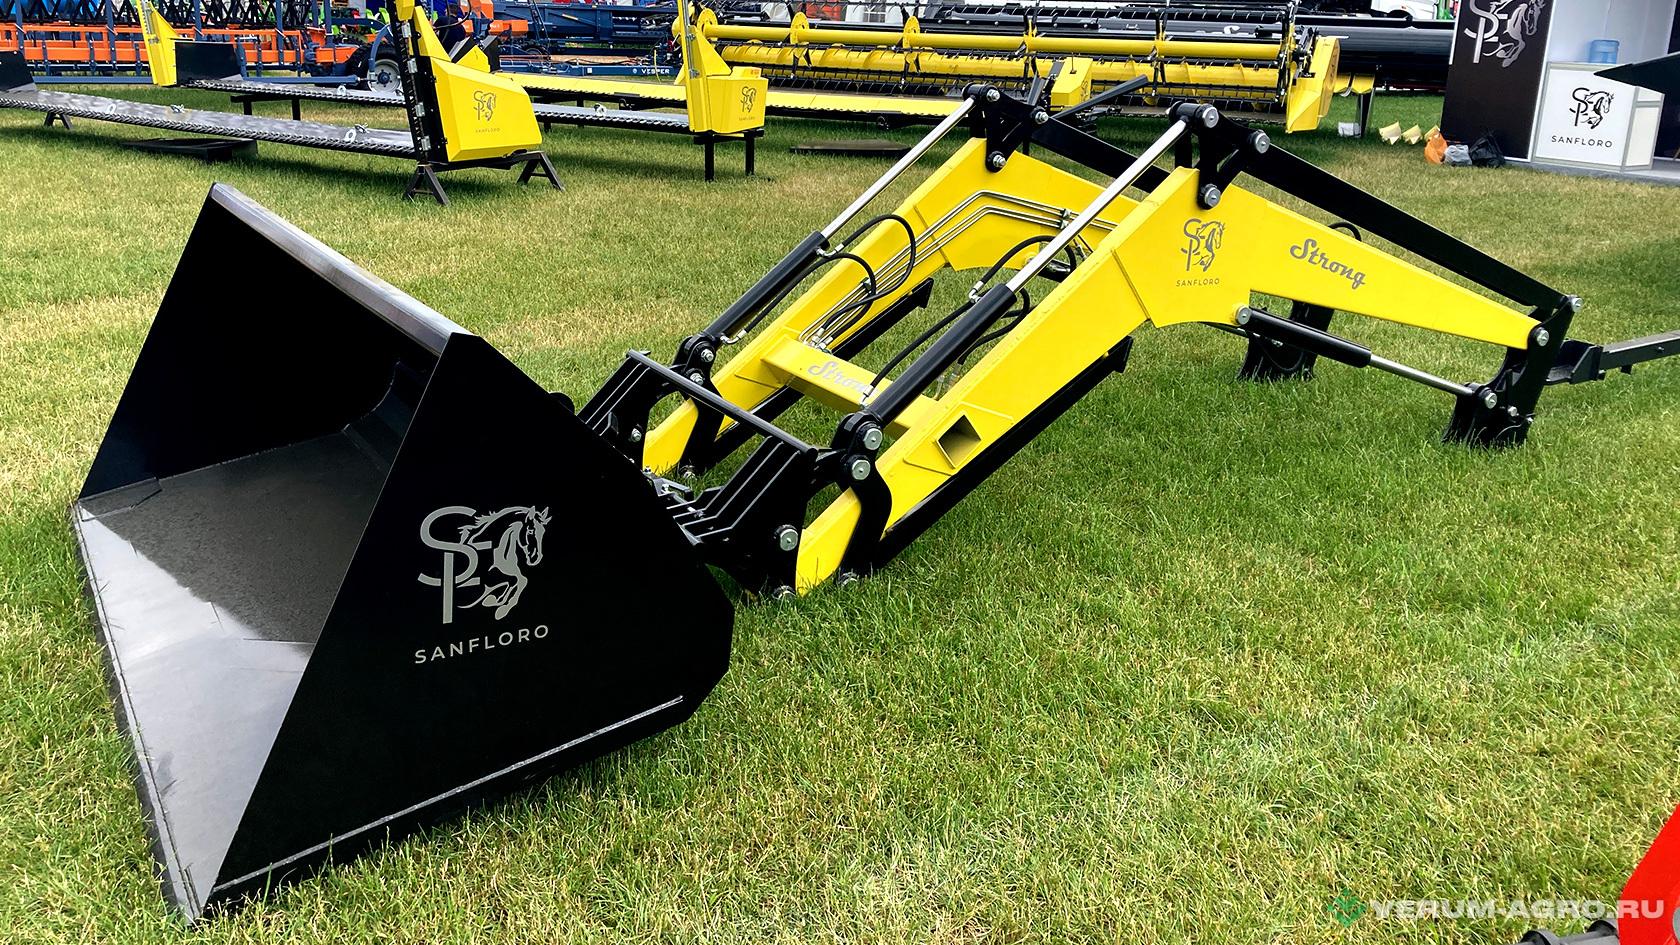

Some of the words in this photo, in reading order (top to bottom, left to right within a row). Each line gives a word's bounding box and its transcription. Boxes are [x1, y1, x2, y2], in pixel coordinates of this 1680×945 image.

[1551, 135, 1613, 148] SANFLORO
[1289, 238, 1366, 290] Strong
[1176, 278, 1220, 287] SANFLORO
[415, 625, 549, 664] SANFLORO
